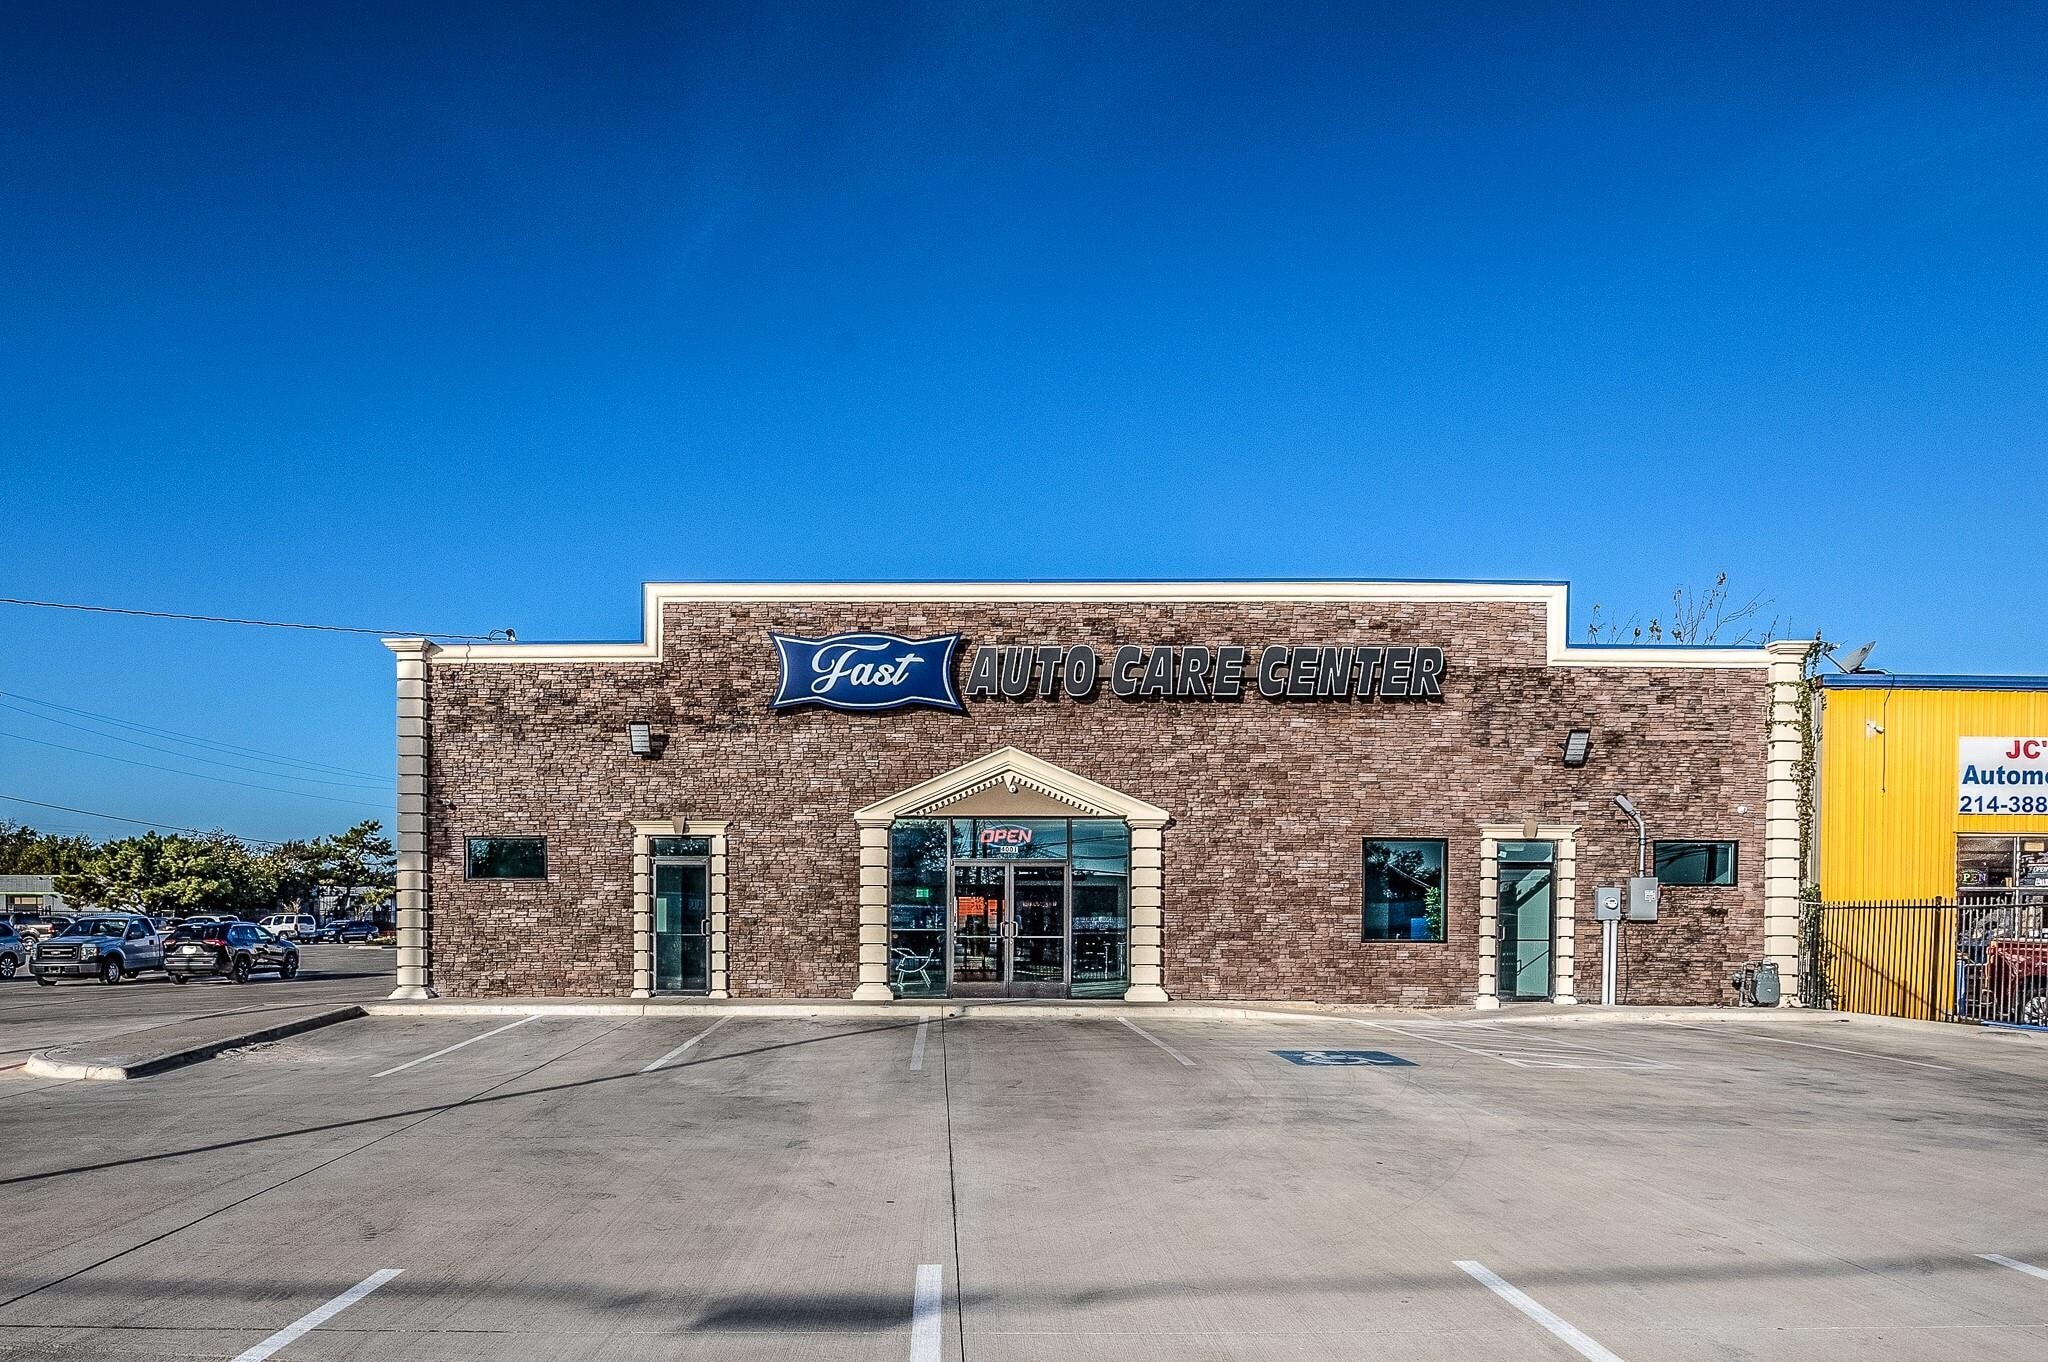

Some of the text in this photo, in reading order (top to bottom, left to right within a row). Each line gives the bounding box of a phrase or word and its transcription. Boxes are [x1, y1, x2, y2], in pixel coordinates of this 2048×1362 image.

[811, 642, 924, 694] Fast
[964, 645, 1444, 696] AUTO CARE CENTER
[1962, 765, 2048, 785] Autom
[981, 829, 1032, 843] OPEN
